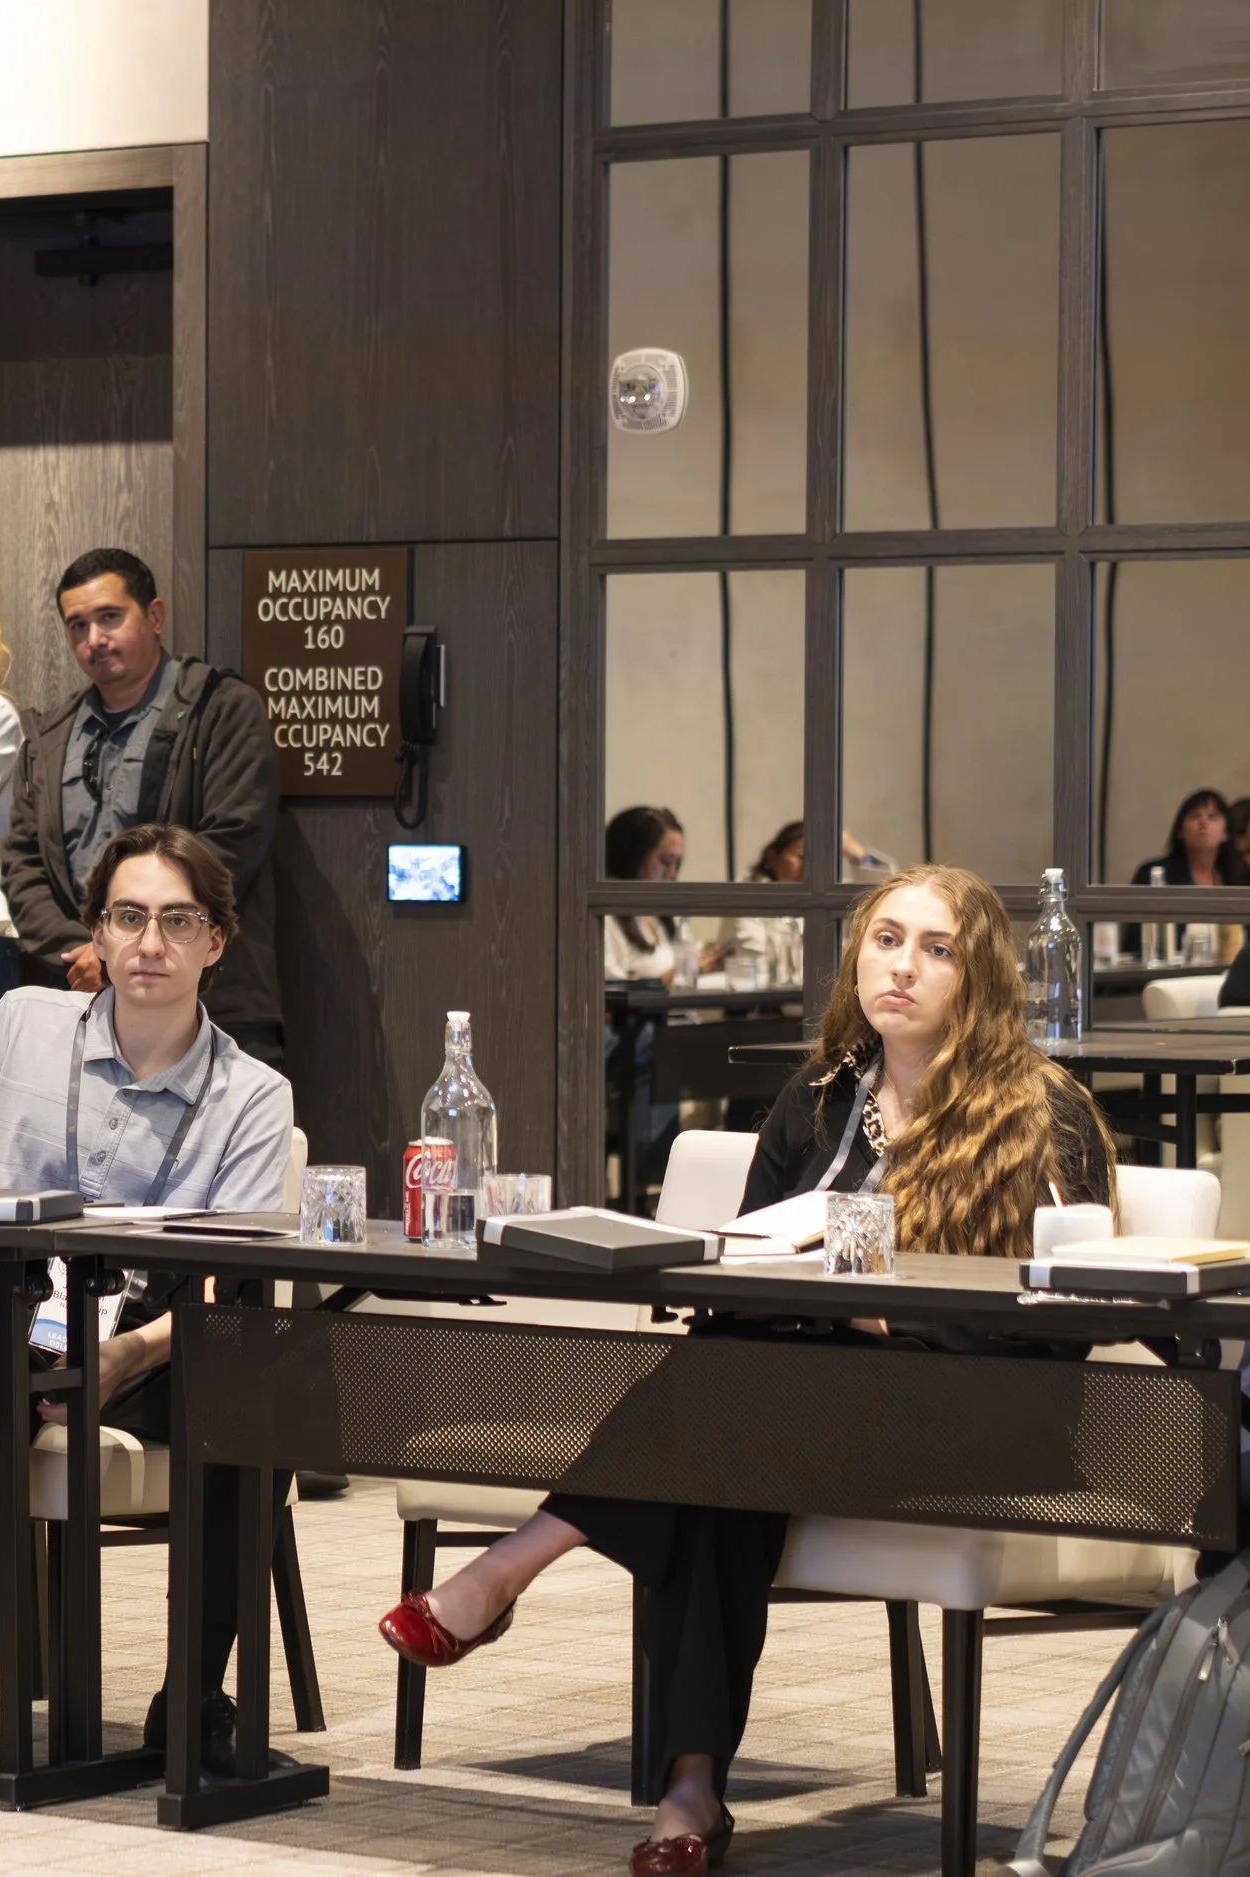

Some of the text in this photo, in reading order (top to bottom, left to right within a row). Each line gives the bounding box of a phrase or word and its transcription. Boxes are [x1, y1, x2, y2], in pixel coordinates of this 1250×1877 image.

[268, 567, 381, 594] MAXIMUM
[257, 595, 391, 623] OCCUPANCY
[304, 624, 345, 650] 160
[264, 666, 383, 692] COMBINED
[267, 695, 379, 720] MAXIMUM
[274, 723, 390, 748] CCUPANCY
[303, 752, 343, 776] 542
